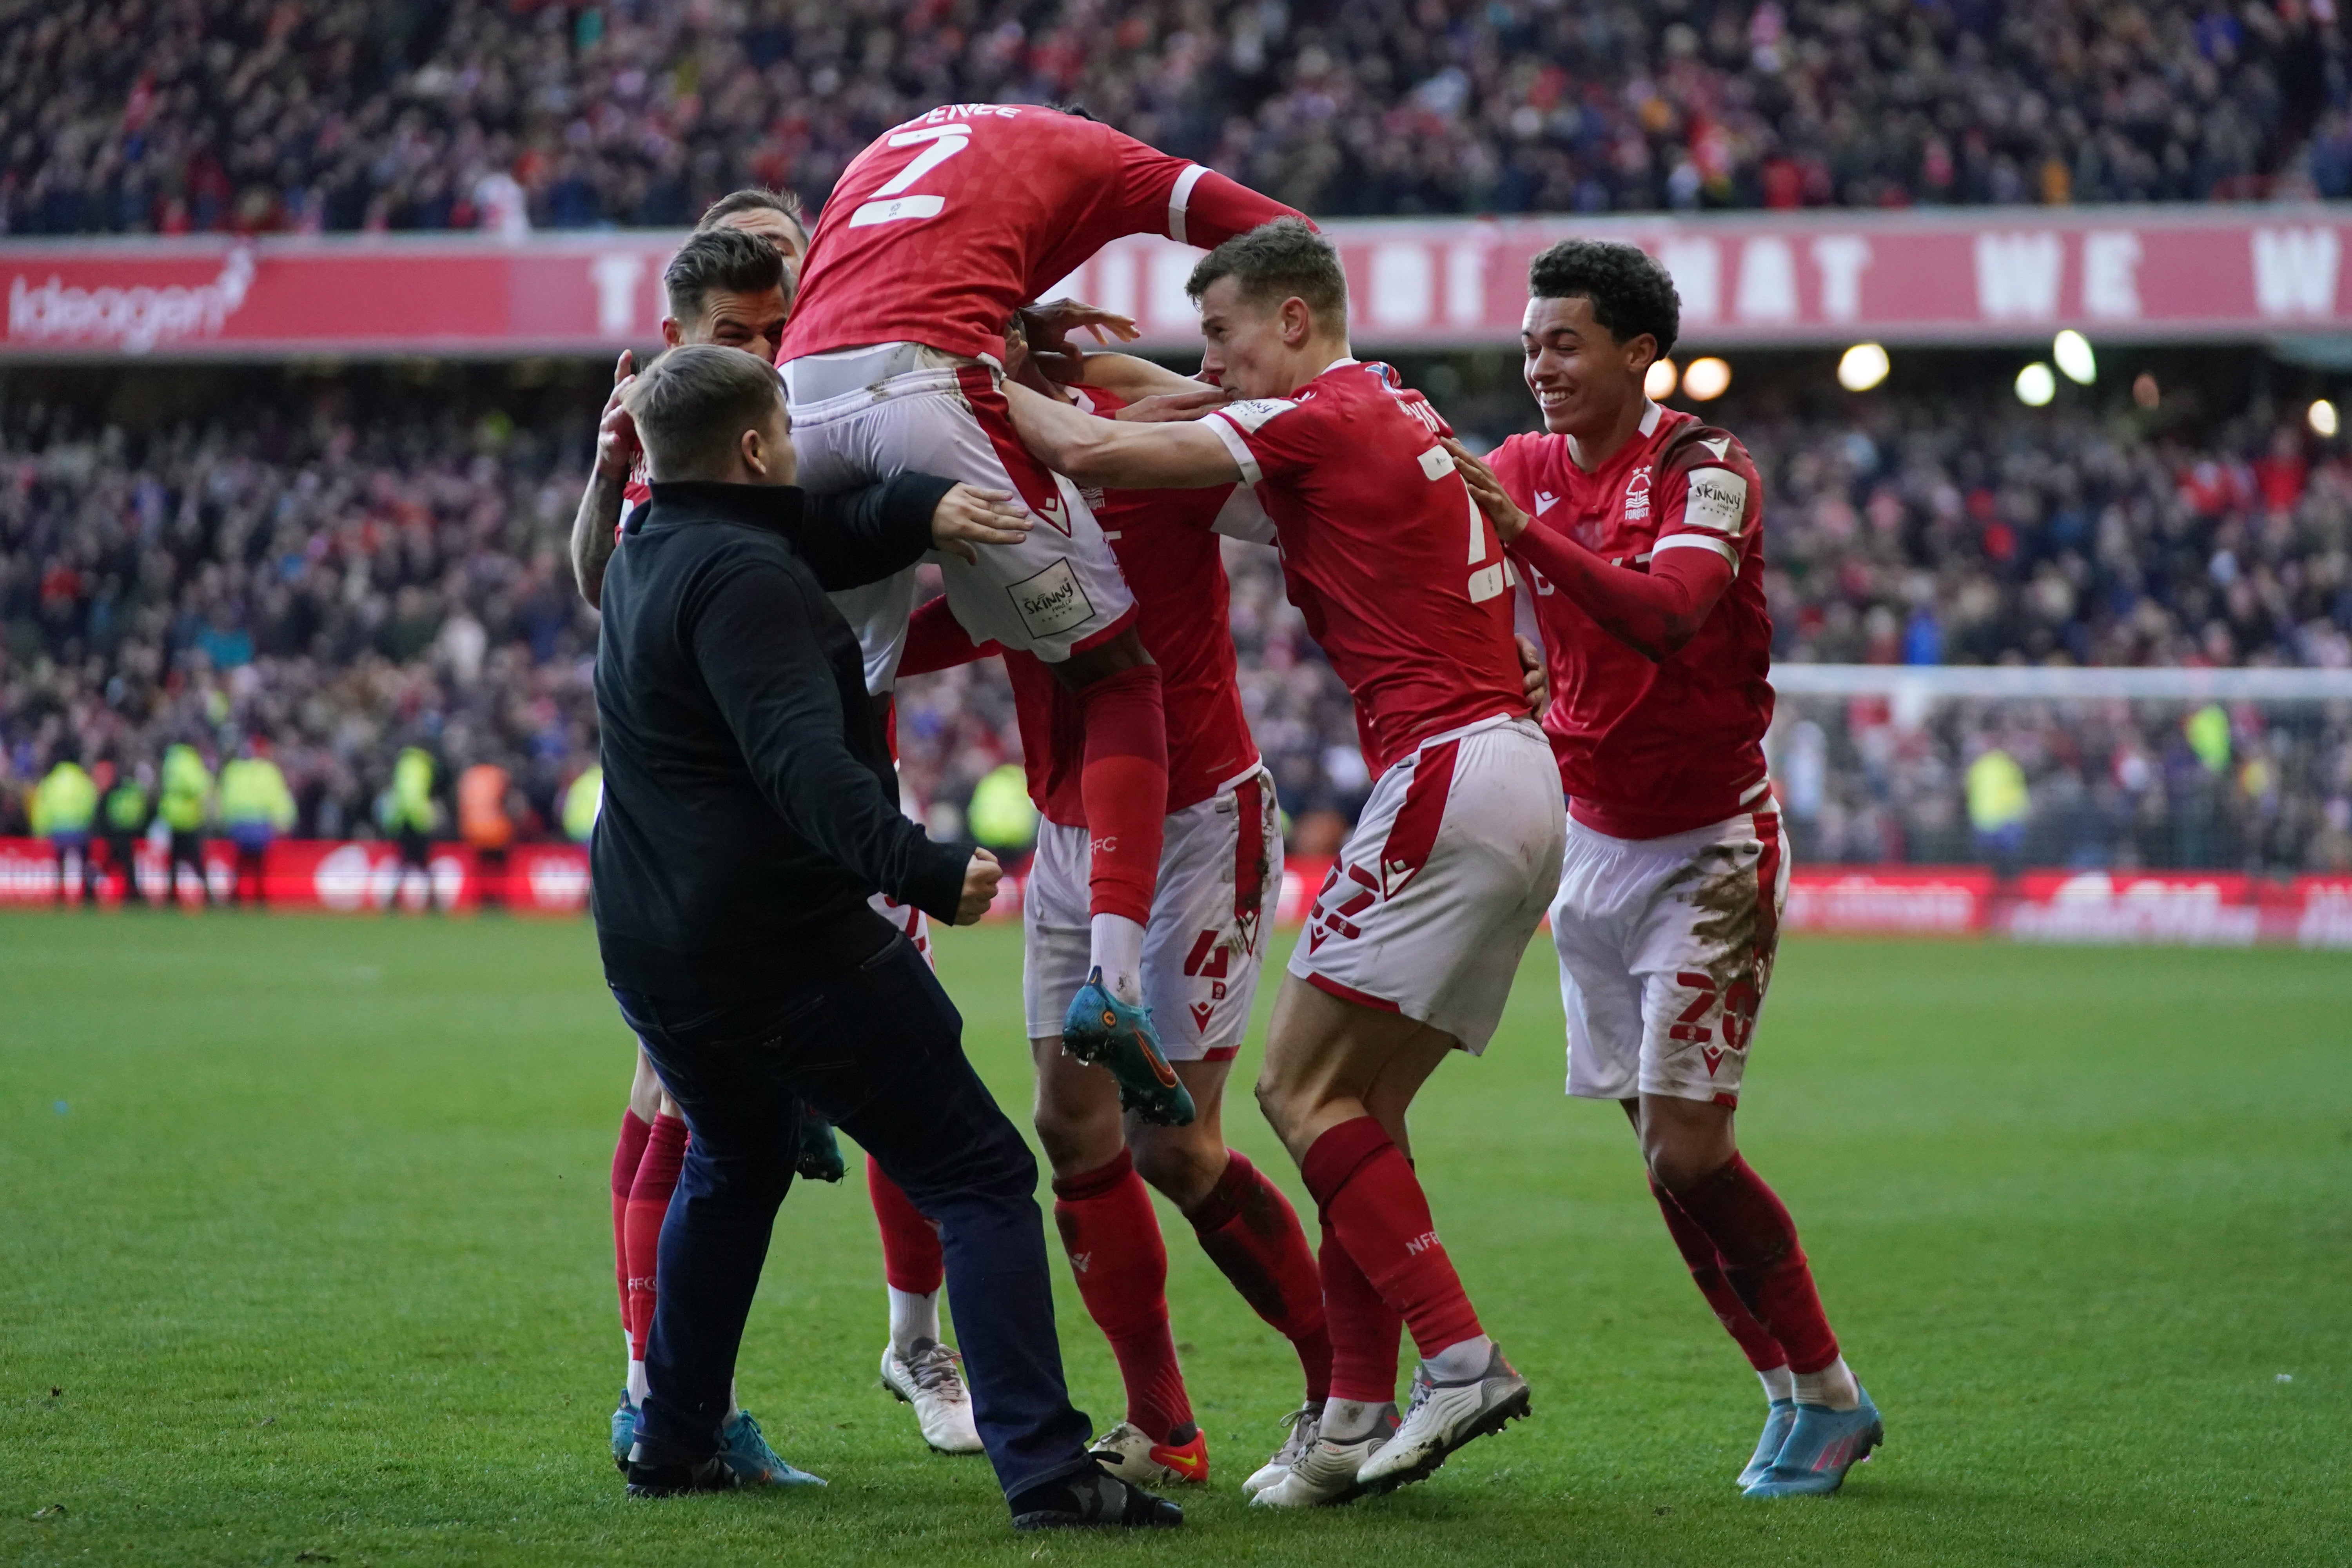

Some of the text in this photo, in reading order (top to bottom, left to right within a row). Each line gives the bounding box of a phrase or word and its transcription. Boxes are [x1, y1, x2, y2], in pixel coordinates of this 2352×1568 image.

[849, 123, 972, 228] 2
[1657, 235, 1876, 323] HAT
[1974, 232, 2144, 319] WE
[1696, 484, 1740, 510] SKINNY
[1024, 582, 1073, 615] SKINNY
[1184, 929, 1229, 1000] 4
[1669, 971, 1763, 1051] 20
